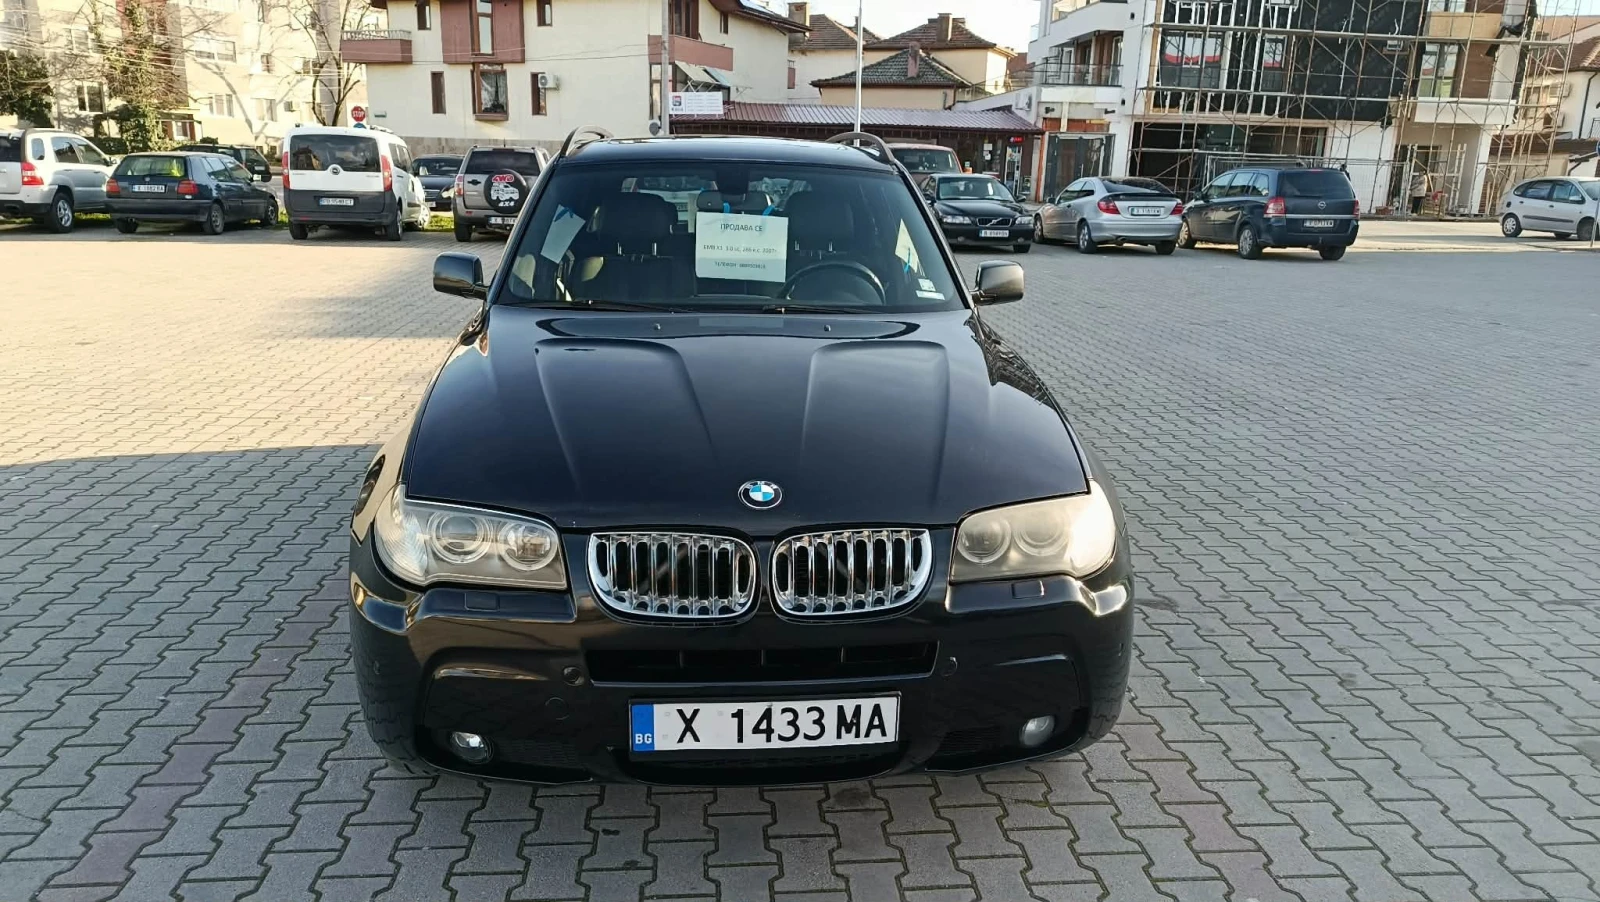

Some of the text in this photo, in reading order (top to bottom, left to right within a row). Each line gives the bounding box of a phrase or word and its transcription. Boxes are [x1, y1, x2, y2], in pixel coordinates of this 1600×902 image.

[720, 223, 753, 231] ПРОДАВА
[676, 703, 888, 743] X 1433 MA
[635, 733, 653, 745] BG
